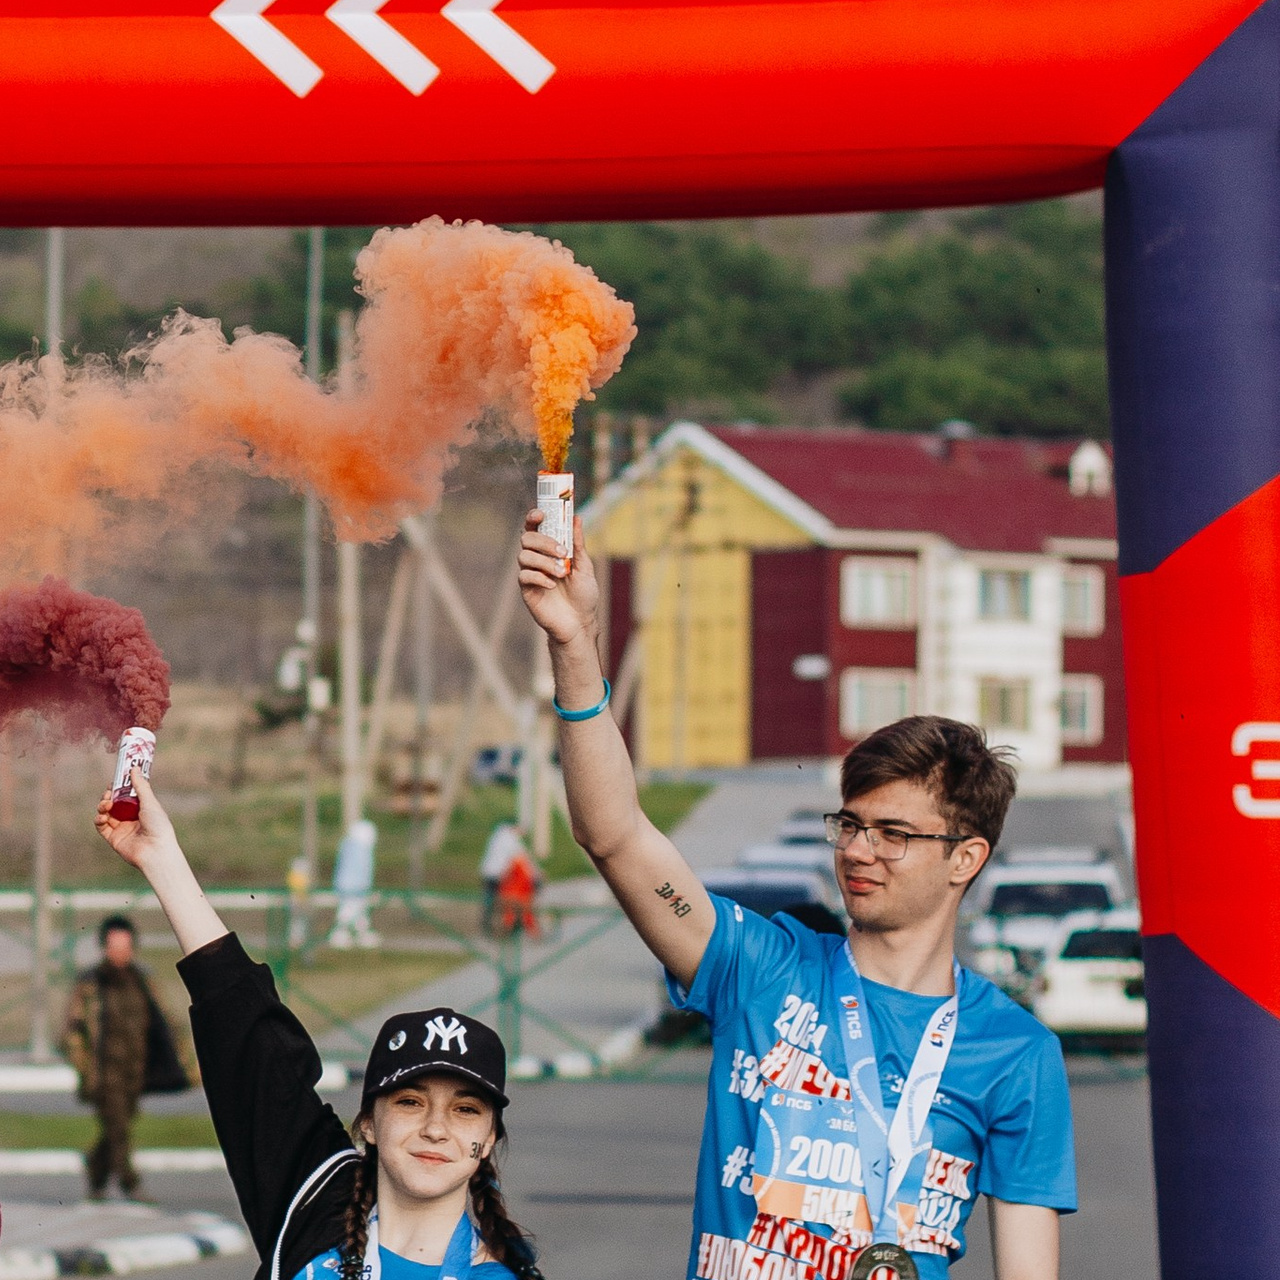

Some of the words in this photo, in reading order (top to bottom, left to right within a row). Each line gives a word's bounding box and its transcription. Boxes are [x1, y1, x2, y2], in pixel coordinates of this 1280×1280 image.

[845, 1010, 863, 1040] ПСБ
[759, 1039, 853, 1102] #МЕЧТ
[786, 1094, 813, 1111] ПСБ
